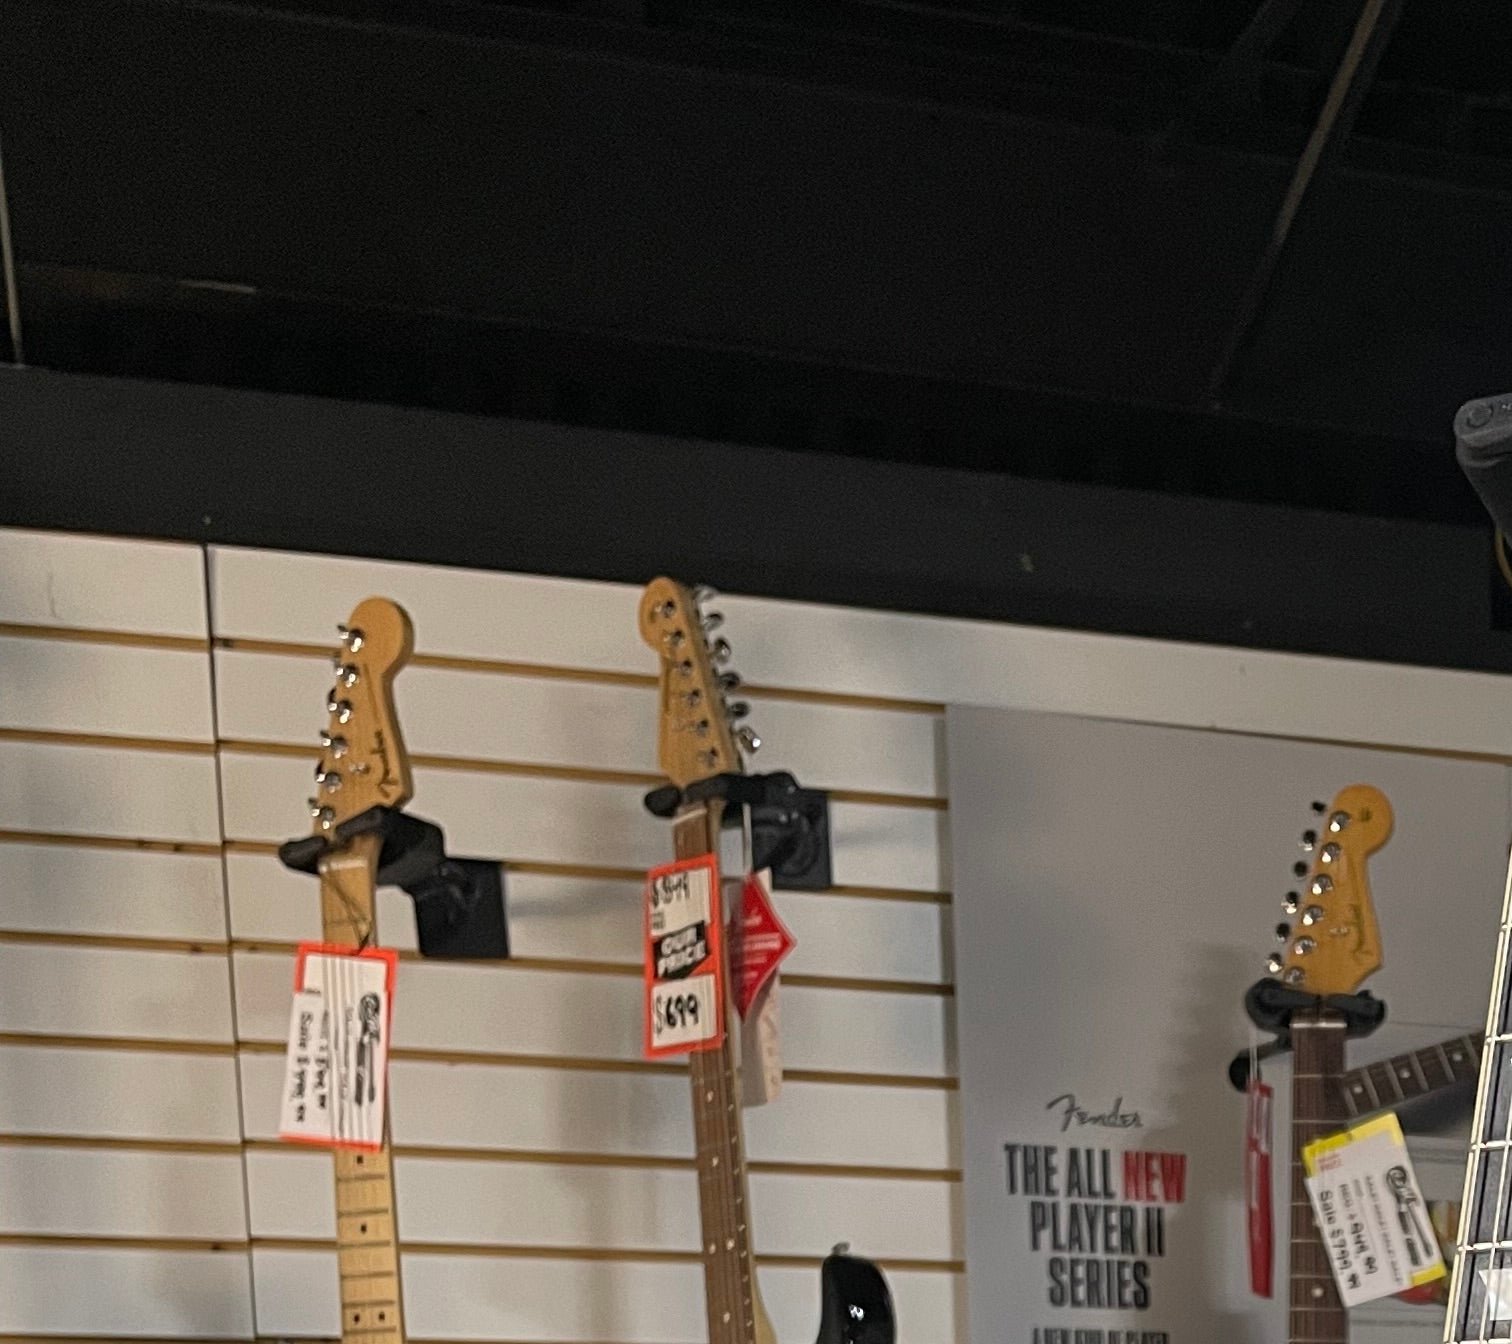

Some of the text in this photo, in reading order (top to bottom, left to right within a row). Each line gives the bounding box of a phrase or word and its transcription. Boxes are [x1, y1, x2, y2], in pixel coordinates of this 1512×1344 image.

[655, 993, 699, 1035] $699
[1046, 1093, 1144, 1133] Fender
[1004, 1143, 1188, 1204] THE ALL NEW
[1030, 1200, 1166, 1257] PLAYER II
[1319, 1188, 1338, 1226] Sale
[1049, 1256, 1150, 1311] SERIES
